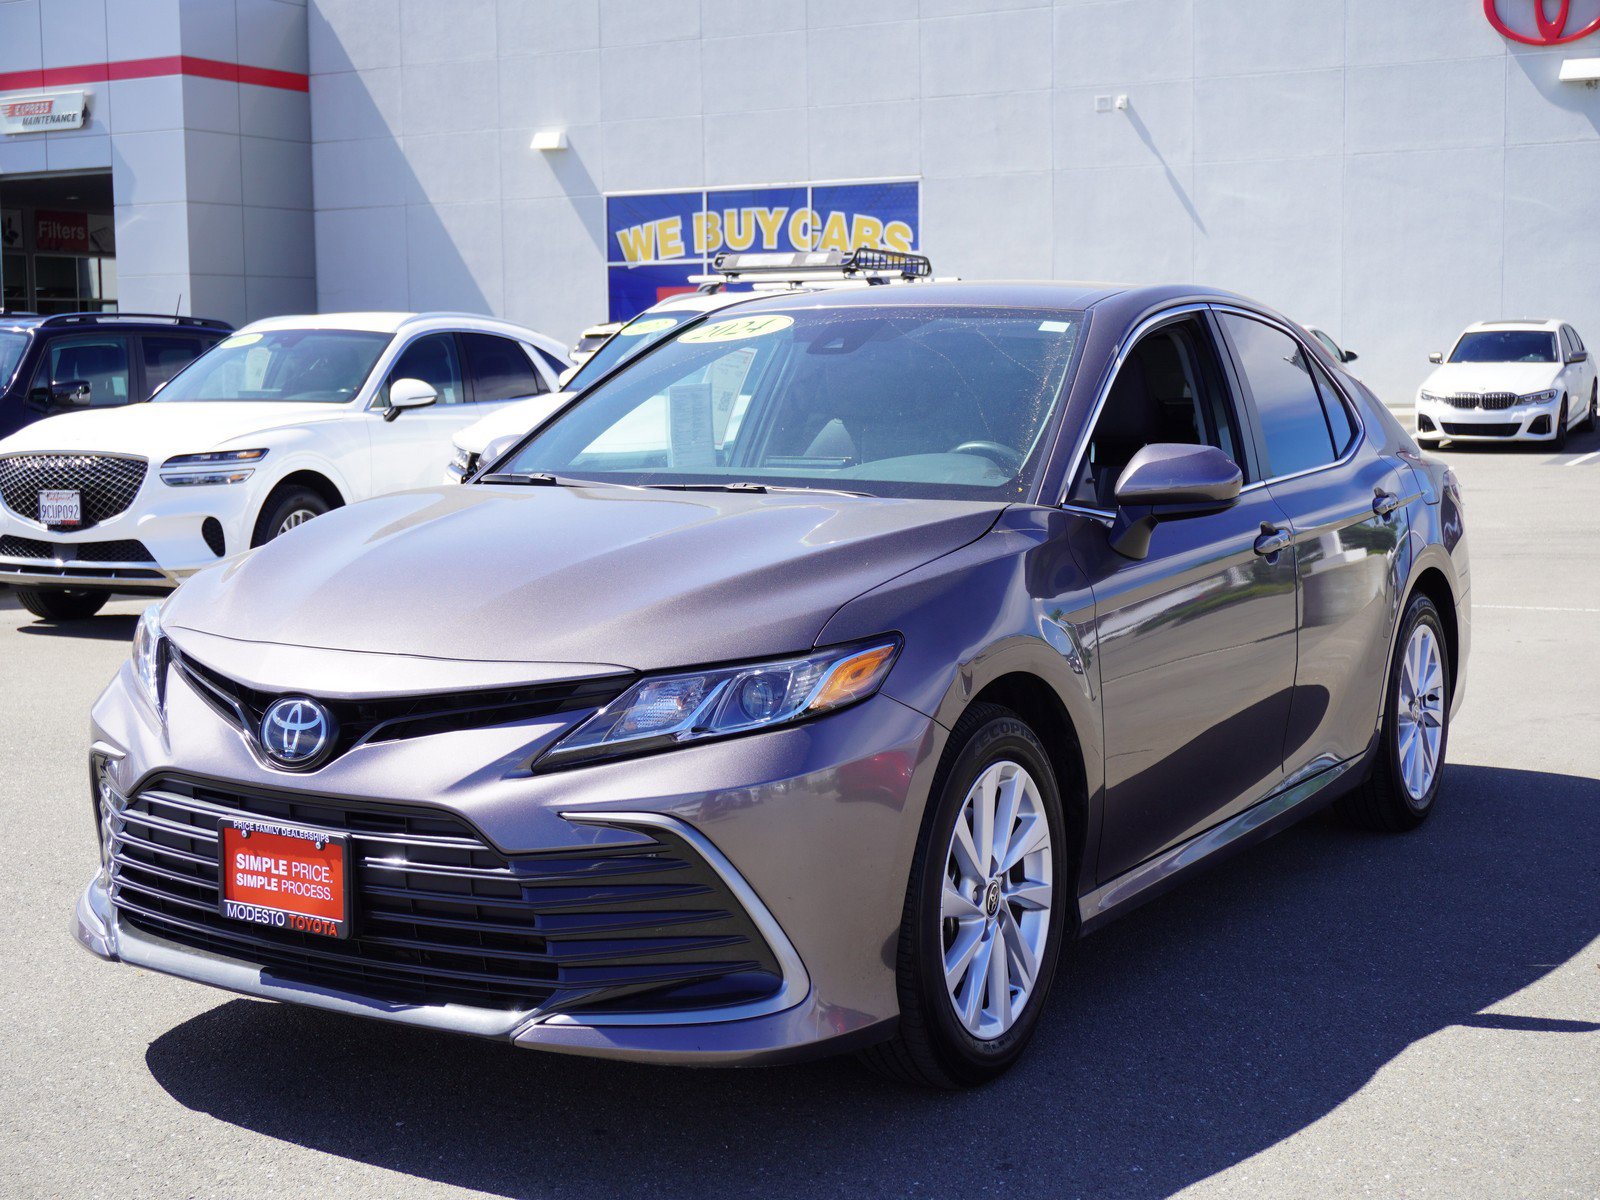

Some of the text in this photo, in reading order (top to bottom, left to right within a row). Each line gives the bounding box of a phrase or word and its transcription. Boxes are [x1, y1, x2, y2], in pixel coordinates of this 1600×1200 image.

[22, 112, 77, 126] MAINTENANCE
[38, 220, 85, 240] Filters
[616, 207, 914, 268] WE BUY CARS
[41, 504, 79, 519] 9CUP092
[233, 820, 330, 843] PRICE FAMILY DEALERSHIPS
[236, 853, 333, 884] SIMPLE PRICE.
[236, 873, 334, 901] SIMPLE PROCESS.
[226, 903, 338, 937] MODESTO TOYOTA
